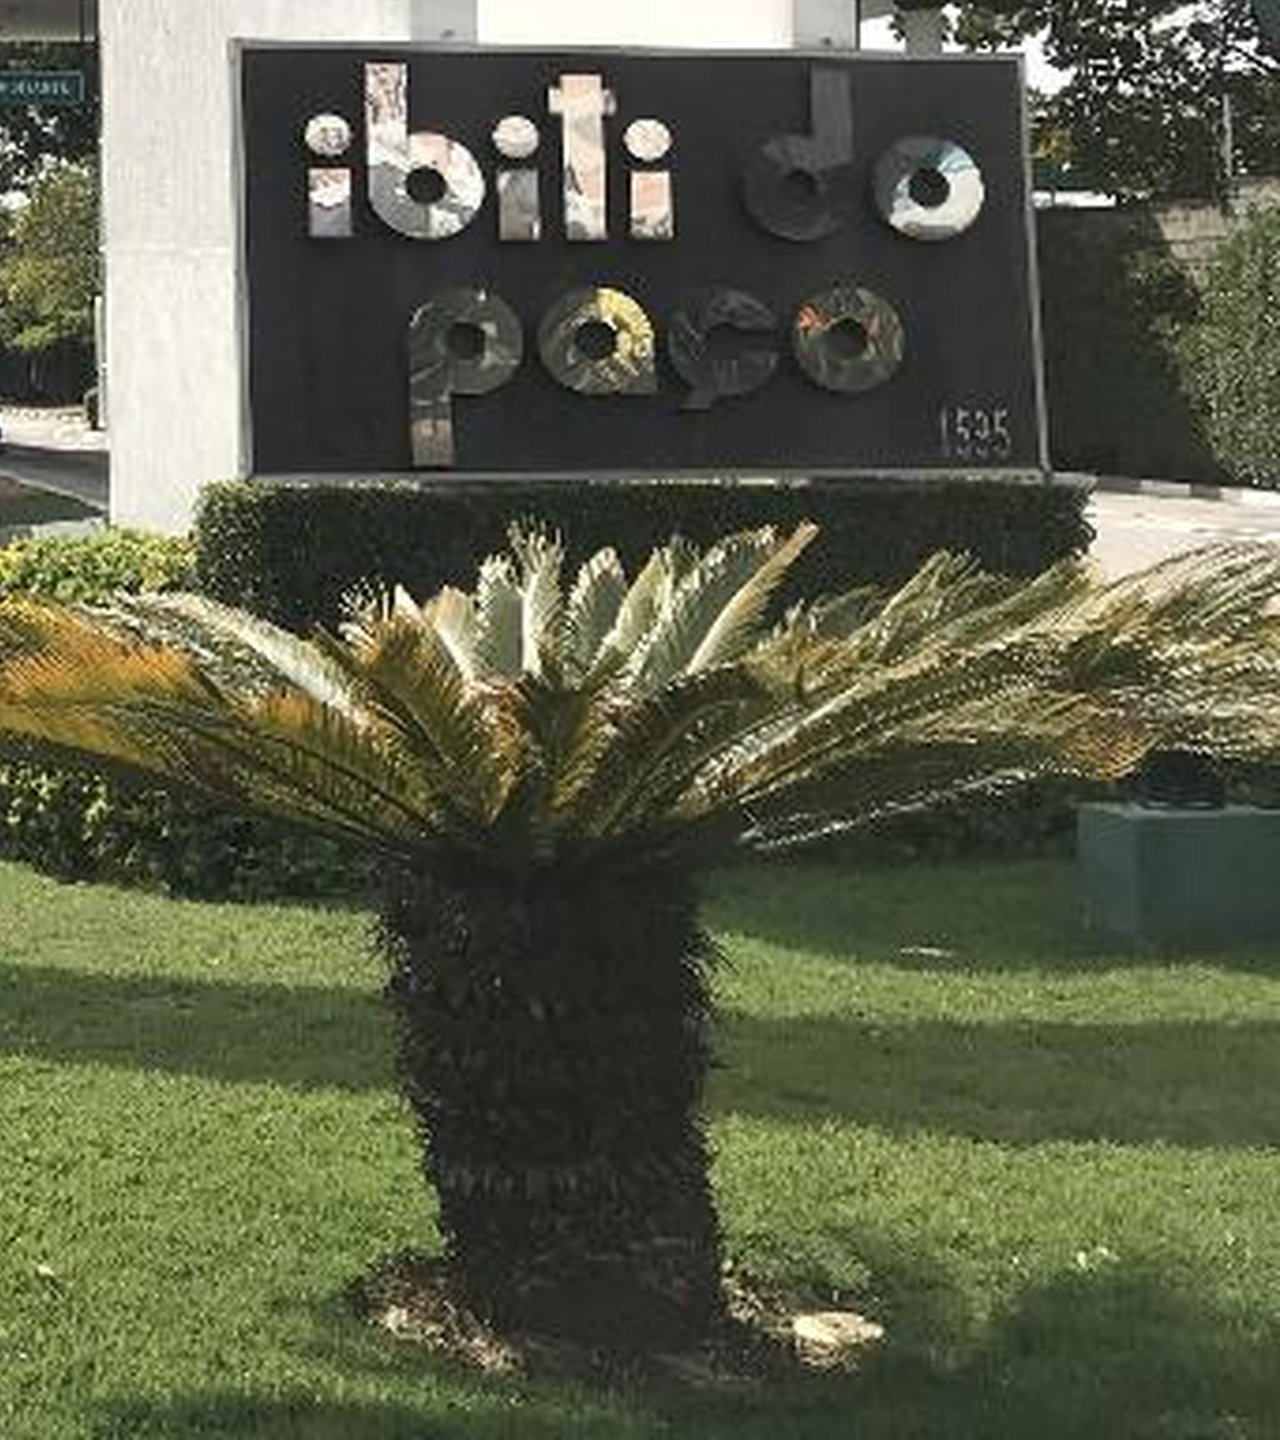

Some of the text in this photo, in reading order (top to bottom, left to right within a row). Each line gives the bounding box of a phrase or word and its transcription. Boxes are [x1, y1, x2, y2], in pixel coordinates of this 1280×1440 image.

[304, 62, 986, 241] ibiti do
[406, 286, 906, 466] paço
